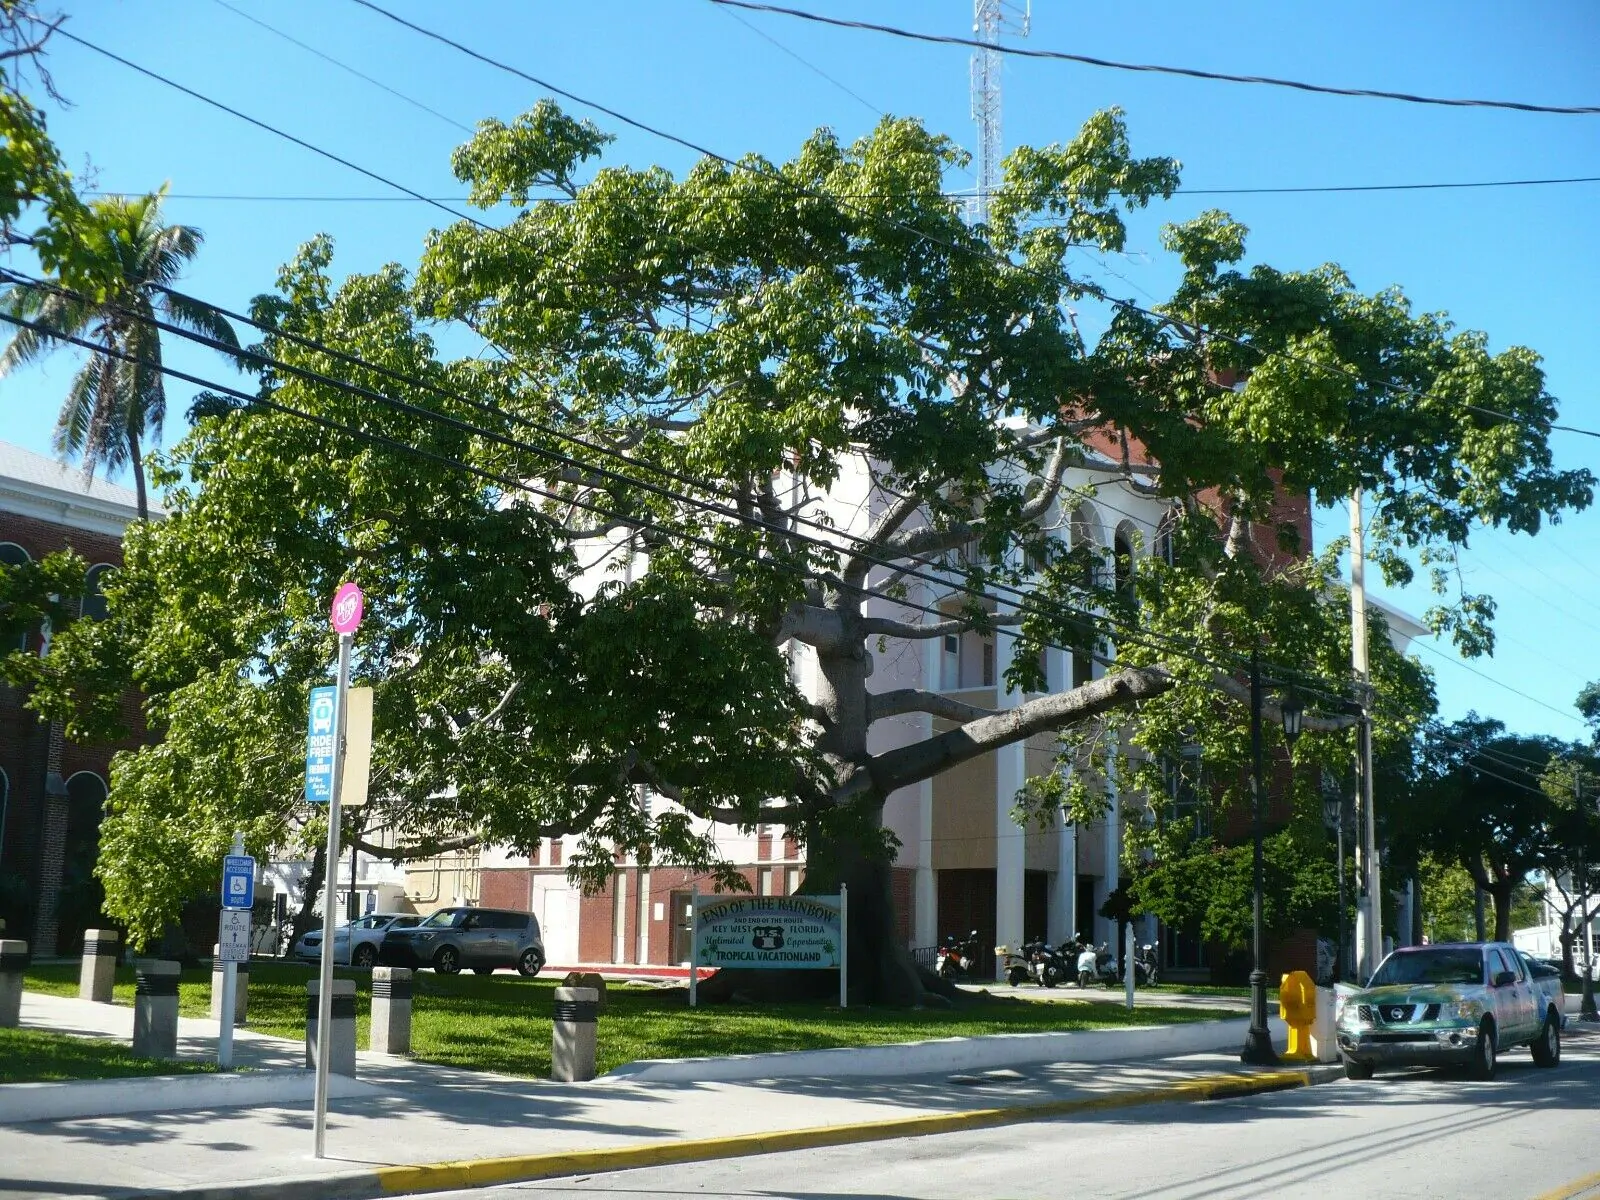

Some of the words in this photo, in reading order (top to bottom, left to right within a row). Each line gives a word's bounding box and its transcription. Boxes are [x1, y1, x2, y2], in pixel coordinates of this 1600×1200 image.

[310, 734, 332, 748] RIDE
[309, 746, 332, 758] FREE
[227, 858, 252, 867] WHEELCHAIR
[226, 866, 252, 874] ACCESSIBLE
[702, 904, 728, 925] END
[729, 900, 745, 914] OF
[751, 898, 775, 911] THE
[778, 899, 838, 922] RAINBOW
[712, 925, 728, 933] KEY
[731, 925, 751, 933] WEST
[755, 929, 781, 938] U.S.
[790, 925, 825, 934] FLORIDA
[705, 935, 745, 946] Unlimited
[716, 951, 755, 961] TROPICAL
[757, 951, 821, 962] VACATIONLAND
